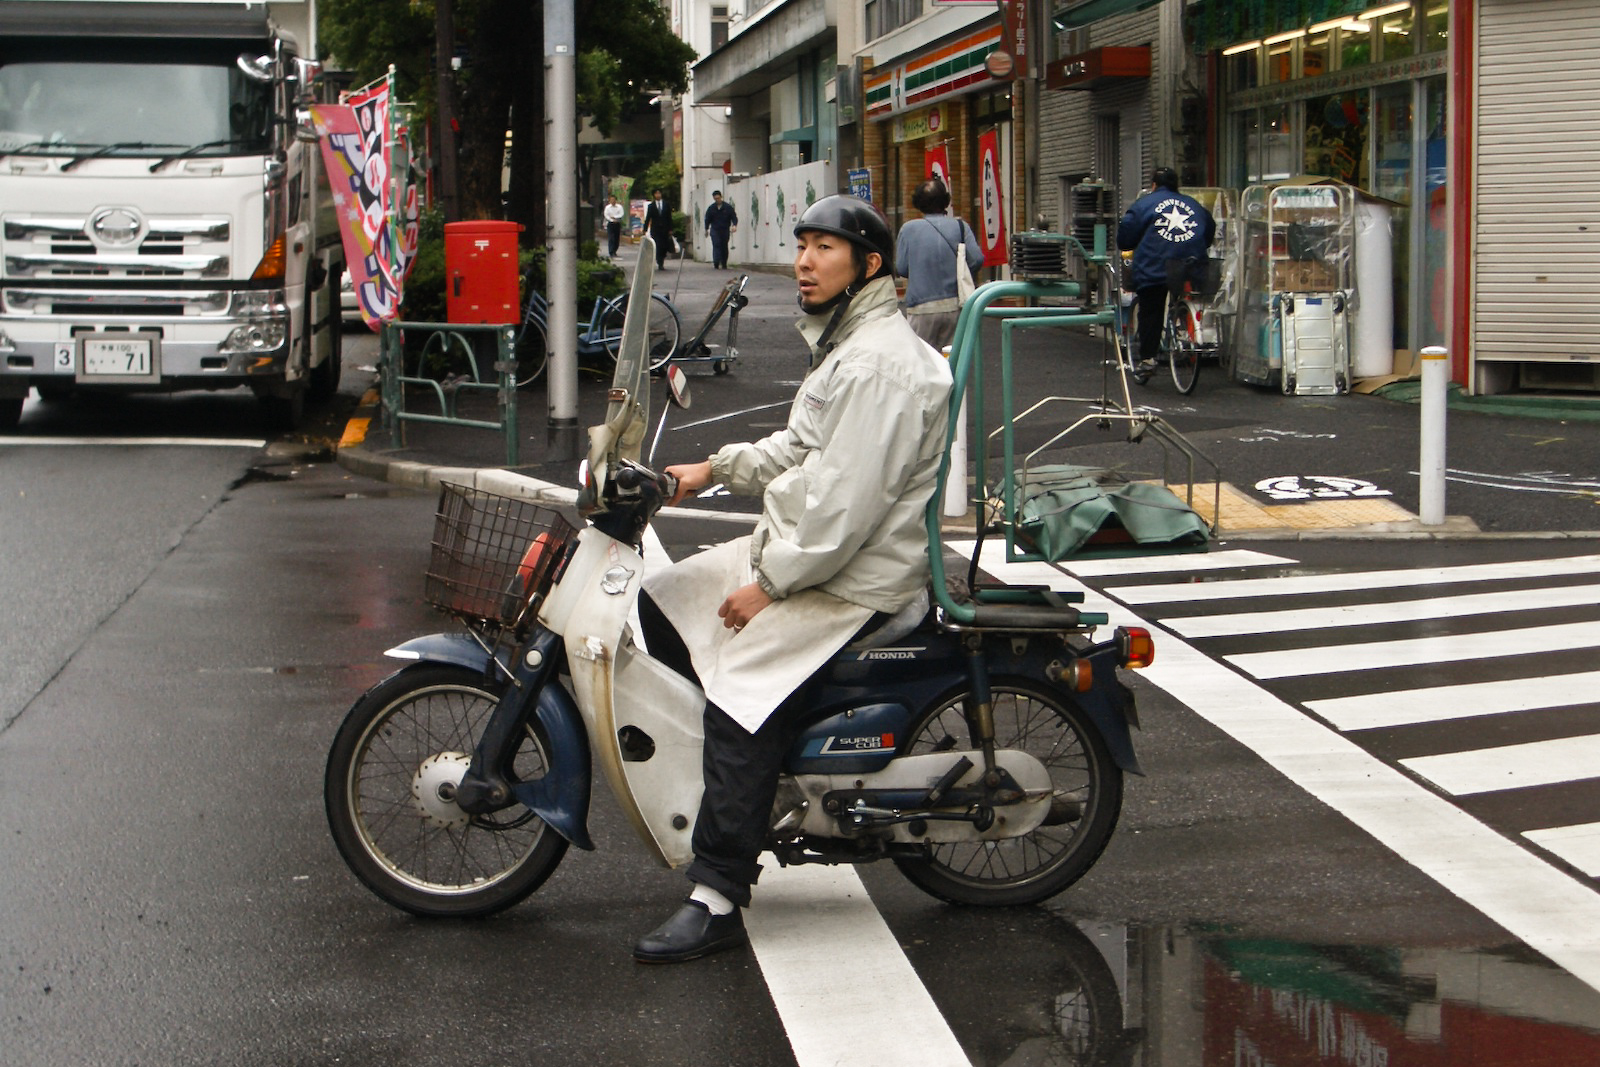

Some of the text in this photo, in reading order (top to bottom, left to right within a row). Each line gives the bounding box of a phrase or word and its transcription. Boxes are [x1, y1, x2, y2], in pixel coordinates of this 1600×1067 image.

[1154, 198, 1195, 216] CONVERSE
[1157, 228, 1196, 243] ALL STAR
[58, 349, 70, 366] 3
[125, 352, 144, 371] 71
[868, 651, 916, 660] HONDA
[839, 736, 881, 745] SUPER
